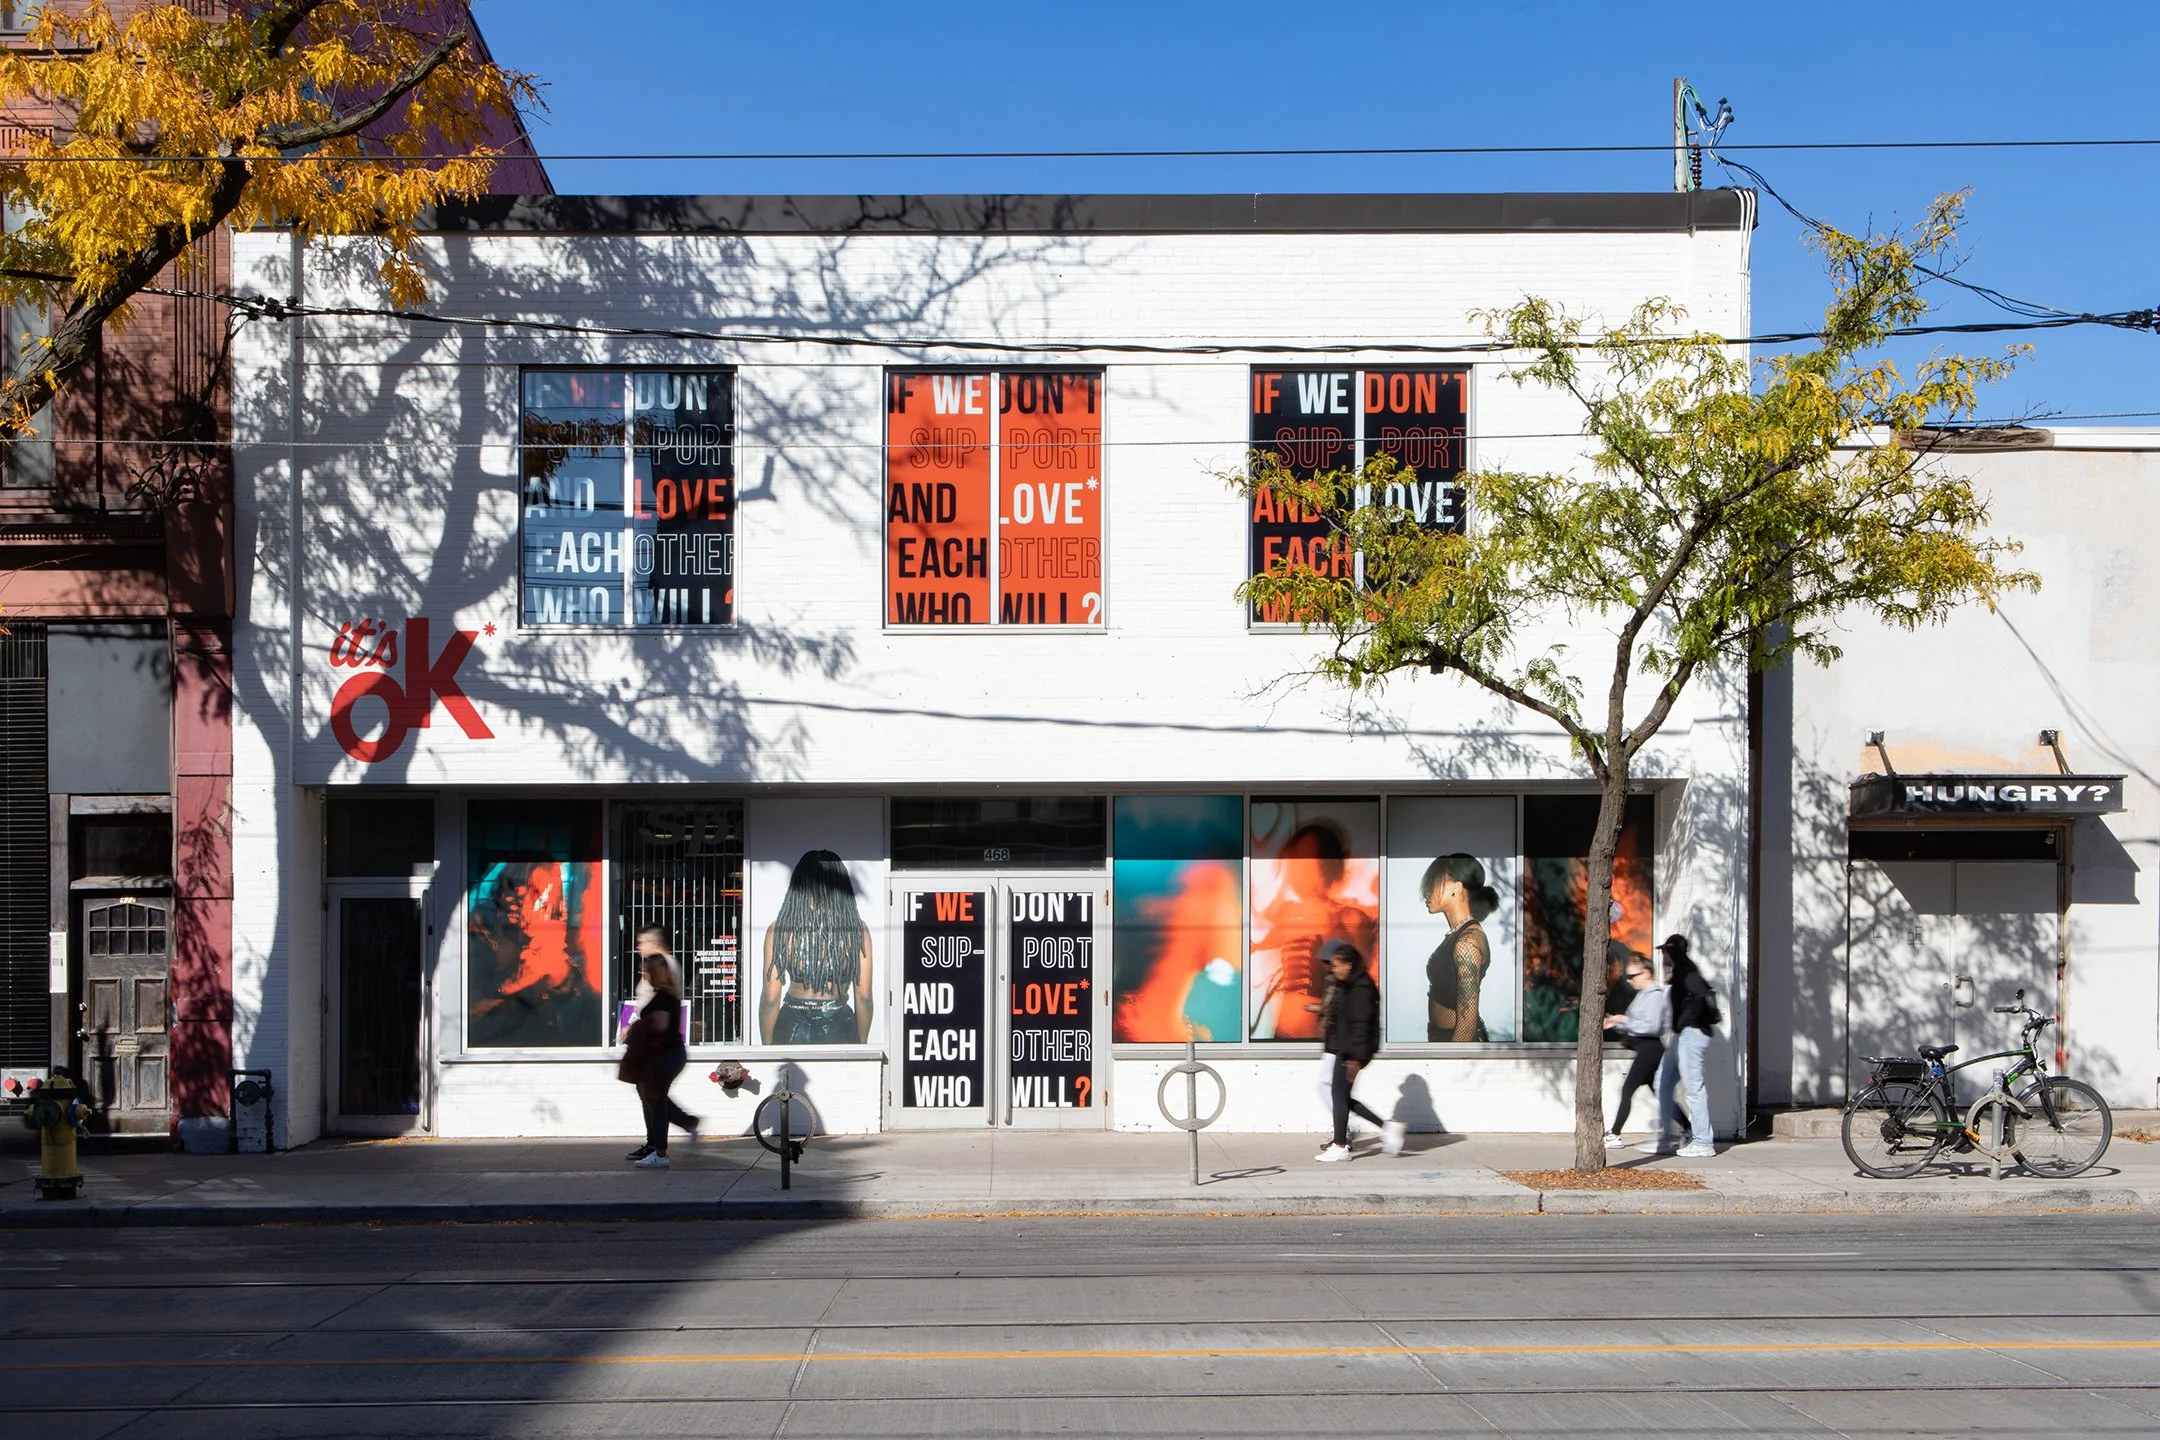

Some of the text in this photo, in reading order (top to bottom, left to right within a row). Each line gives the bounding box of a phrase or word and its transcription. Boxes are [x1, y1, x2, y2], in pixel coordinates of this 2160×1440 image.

[888, 374, 1101, 414] IF WE DON'T
[1253, 372, 1466, 414] IF WE DON'T
[910, 428, 1101, 469] SUP- PORT
[1275, 427, 1466, 470] SUP- PORT
[525, 477, 595, 518] AND
[888, 483, 957, 523] AND
[535, 531, 625, 573] EACH
[898, 537, 1101, 579] EACH OTHER
[1263, 536, 1353, 578] EACH
[533, 587, 610, 624] WHO
[896, 592, 971, 624] WHO
[329, 617, 398, 668] it's
[1905, 784, 2110, 802] HUNGRY?
[984, 849, 1009, 861] 468
[904, 892, 1093, 922] IF WE DON'T
[921, 936, 1092, 968] SUP- PORT
[904, 983, 954, 1015] AND
[908, 1029, 1091, 1062] EACH OTHER
[913, 1076, 1091, 1107] WHO WILL?
